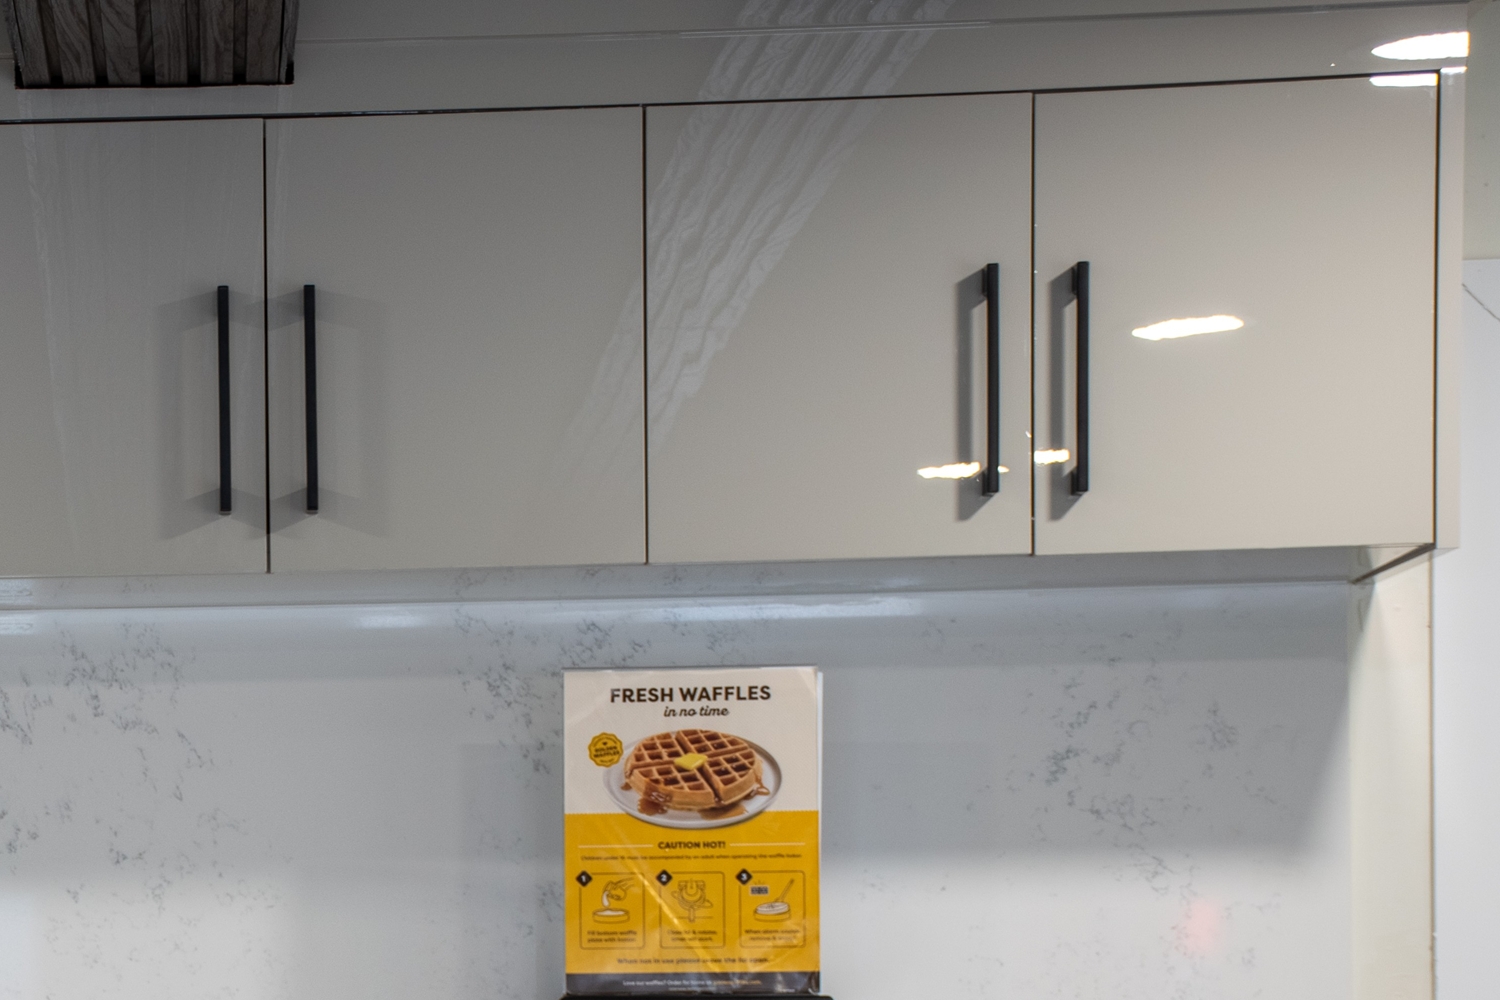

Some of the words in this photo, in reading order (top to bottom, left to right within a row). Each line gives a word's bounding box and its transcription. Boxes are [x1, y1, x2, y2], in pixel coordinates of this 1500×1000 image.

[610, 688, 673, 703] FRESH
[679, 685, 771, 701] WAFFLES
[663, 706, 677, 717] in
[679, 708, 697, 717] no
[699, 705, 730, 717] time
[658, 841, 700, 850] CAUTION
[703, 841, 726, 849] HOT!
[580, 875, 587, 883] 1
[660, 874, 668, 882] 2
[740, 873, 748, 881] 3
